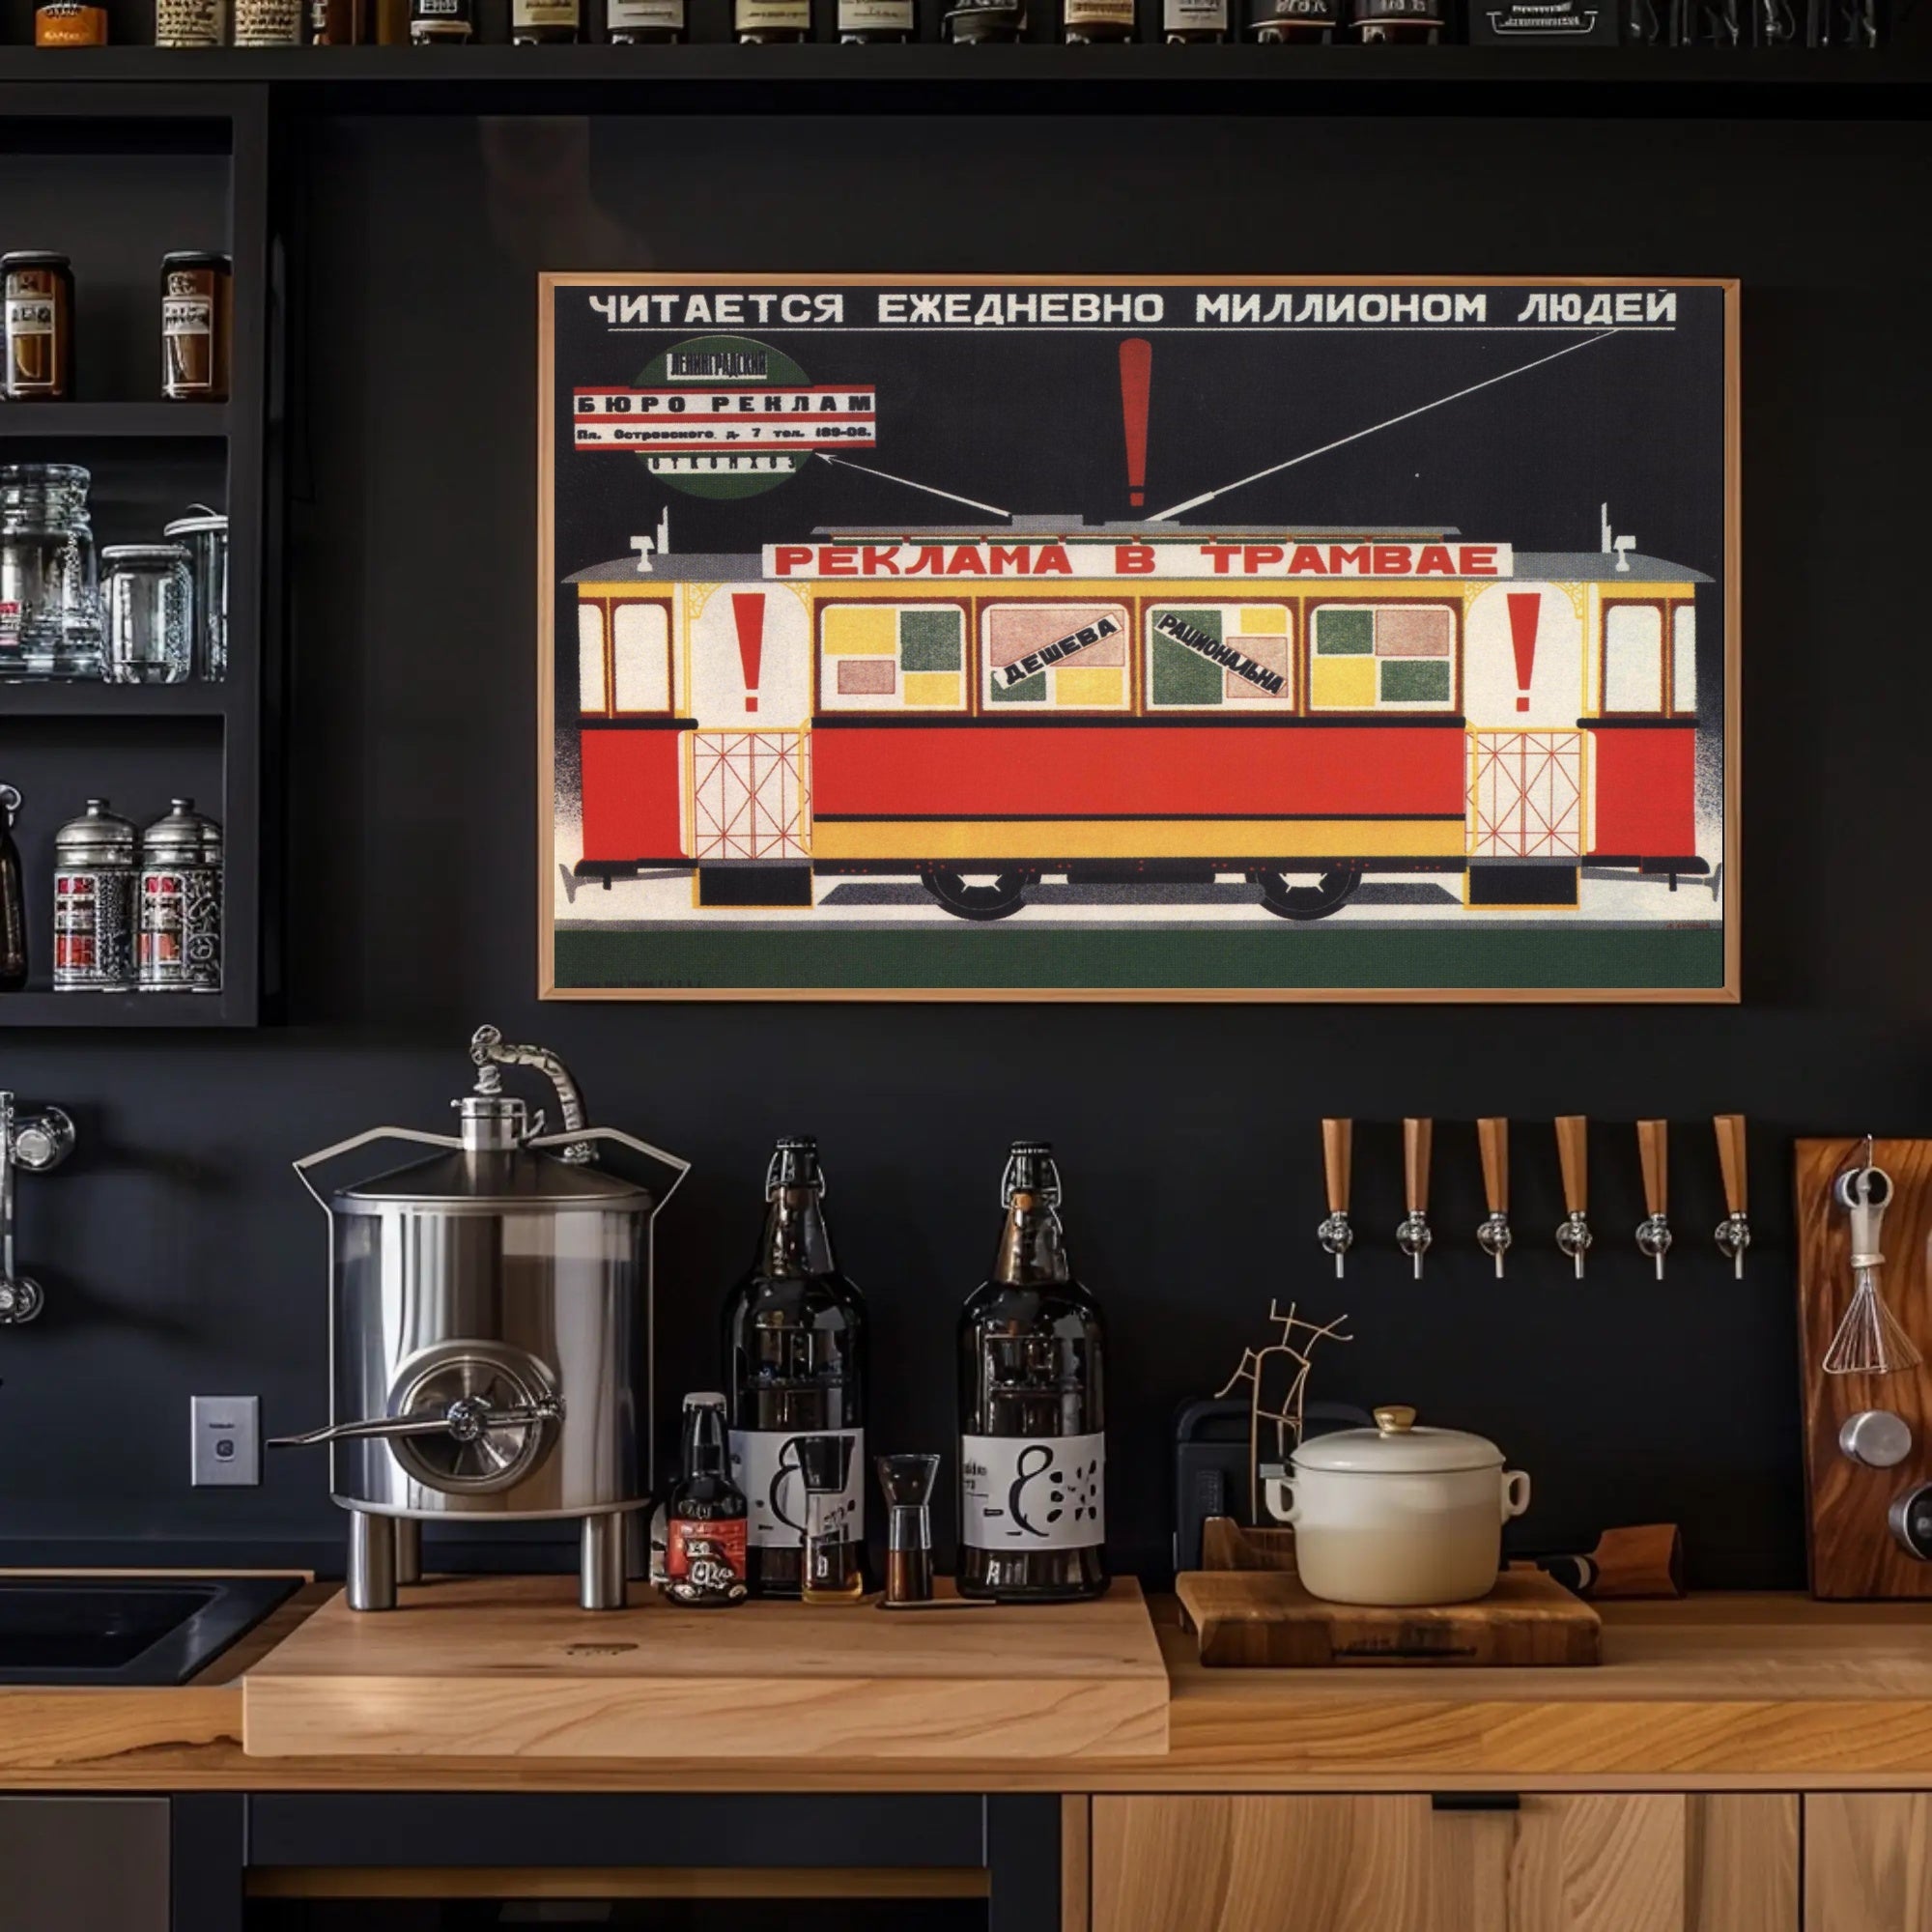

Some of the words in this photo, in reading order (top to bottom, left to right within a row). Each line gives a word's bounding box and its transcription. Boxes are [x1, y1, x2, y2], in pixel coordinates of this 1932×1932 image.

[588, 294, 844, 324] ЧИТАЕТСЯ
[877, 293, 1164, 326] ЕЖЕДНЕВНО
[1196, 293, 1488, 324] МИЛЛИОНОМ
[1517, 290, 1678, 326] ЛЮДЕЙ
[578, 396, 686, 413] БЮРО
[711, 395, 872, 412] РЕКЛАМ
[752, 427, 761, 438] 7
[775, 545, 1073, 576] РЕКЛАМА
[1114, 546, 1156, 576] В
[1200, 545, 1499, 576] ТРАМВАЕ
[1005, 617, 1119, 686] ДЕШЕВА
[1157, 614, 1286, 695] РАЦИОНАЛЬНА
